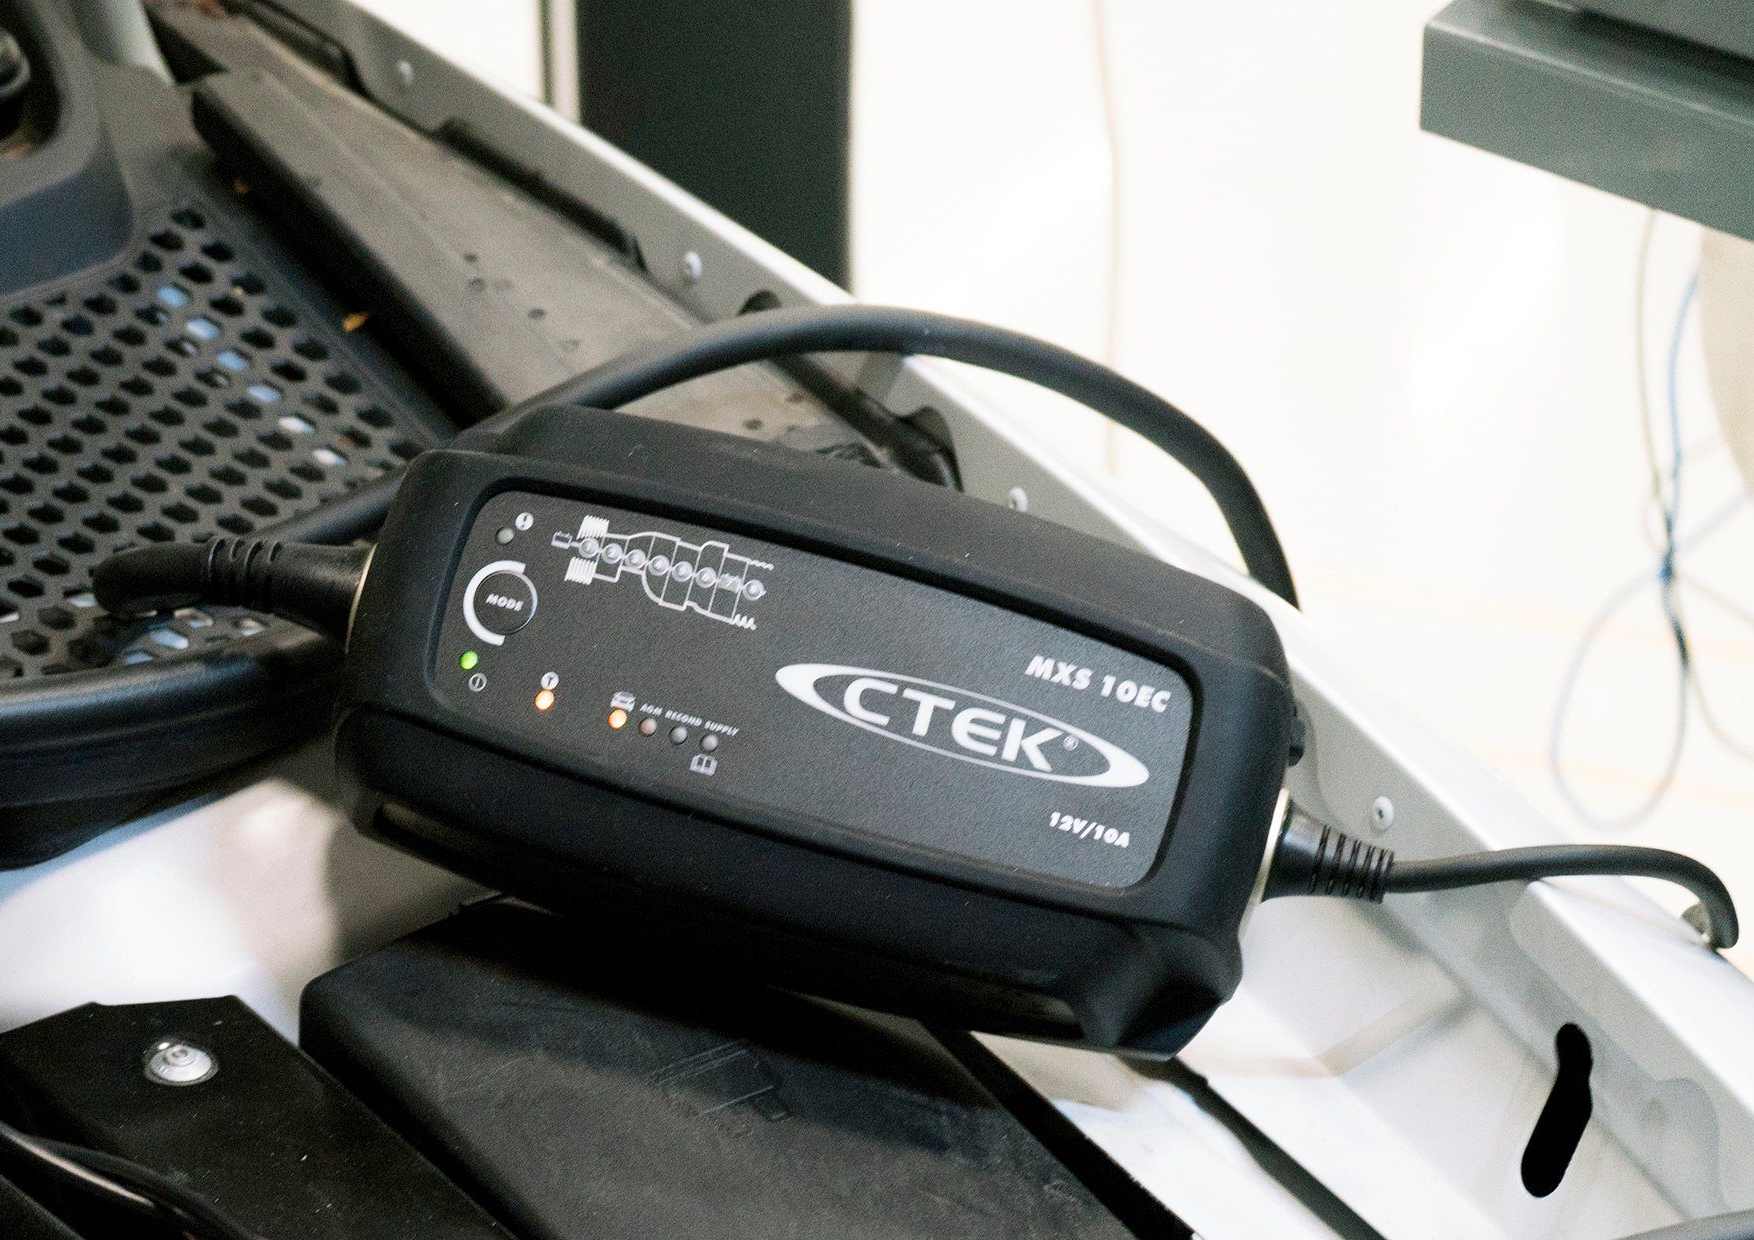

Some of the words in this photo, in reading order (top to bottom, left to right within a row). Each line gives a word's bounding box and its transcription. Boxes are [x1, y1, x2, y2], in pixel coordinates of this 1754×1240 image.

[485, 593, 524, 612] MODE
[1025, 655, 1094, 691] MXS
[1099, 675, 1171, 714] 10EC
[703, 720, 740, 737] SUPPLY
[843, 677, 1066, 773] CTEK
[1049, 811, 1131, 848] 12V/10A
